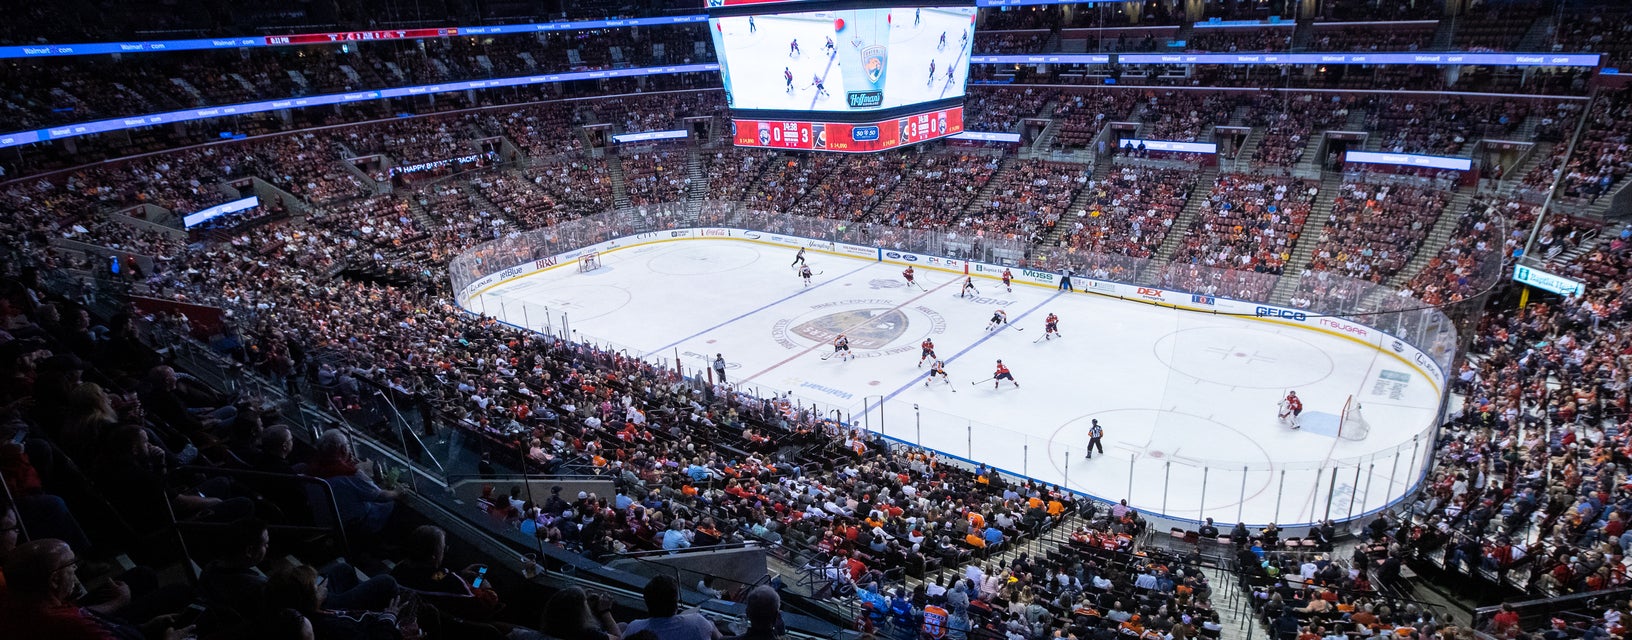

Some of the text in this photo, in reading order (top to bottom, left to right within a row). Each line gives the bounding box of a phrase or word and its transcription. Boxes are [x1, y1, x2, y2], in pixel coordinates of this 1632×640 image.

[911, 122, 916, 136] 3
[931, 119, 936, 132] 0
[774, 127, 780, 141] 0
[802, 129, 808, 142] 3
[404, 164, 425, 173] HAPPY
[536, 256, 558, 269] BB&T
[500, 267, 522, 280] jetBlue
[1023, 270, 1053, 280] MOSS
[1137, 288, 1162, 297] DEX
[1256, 306, 1306, 321] GEICO
